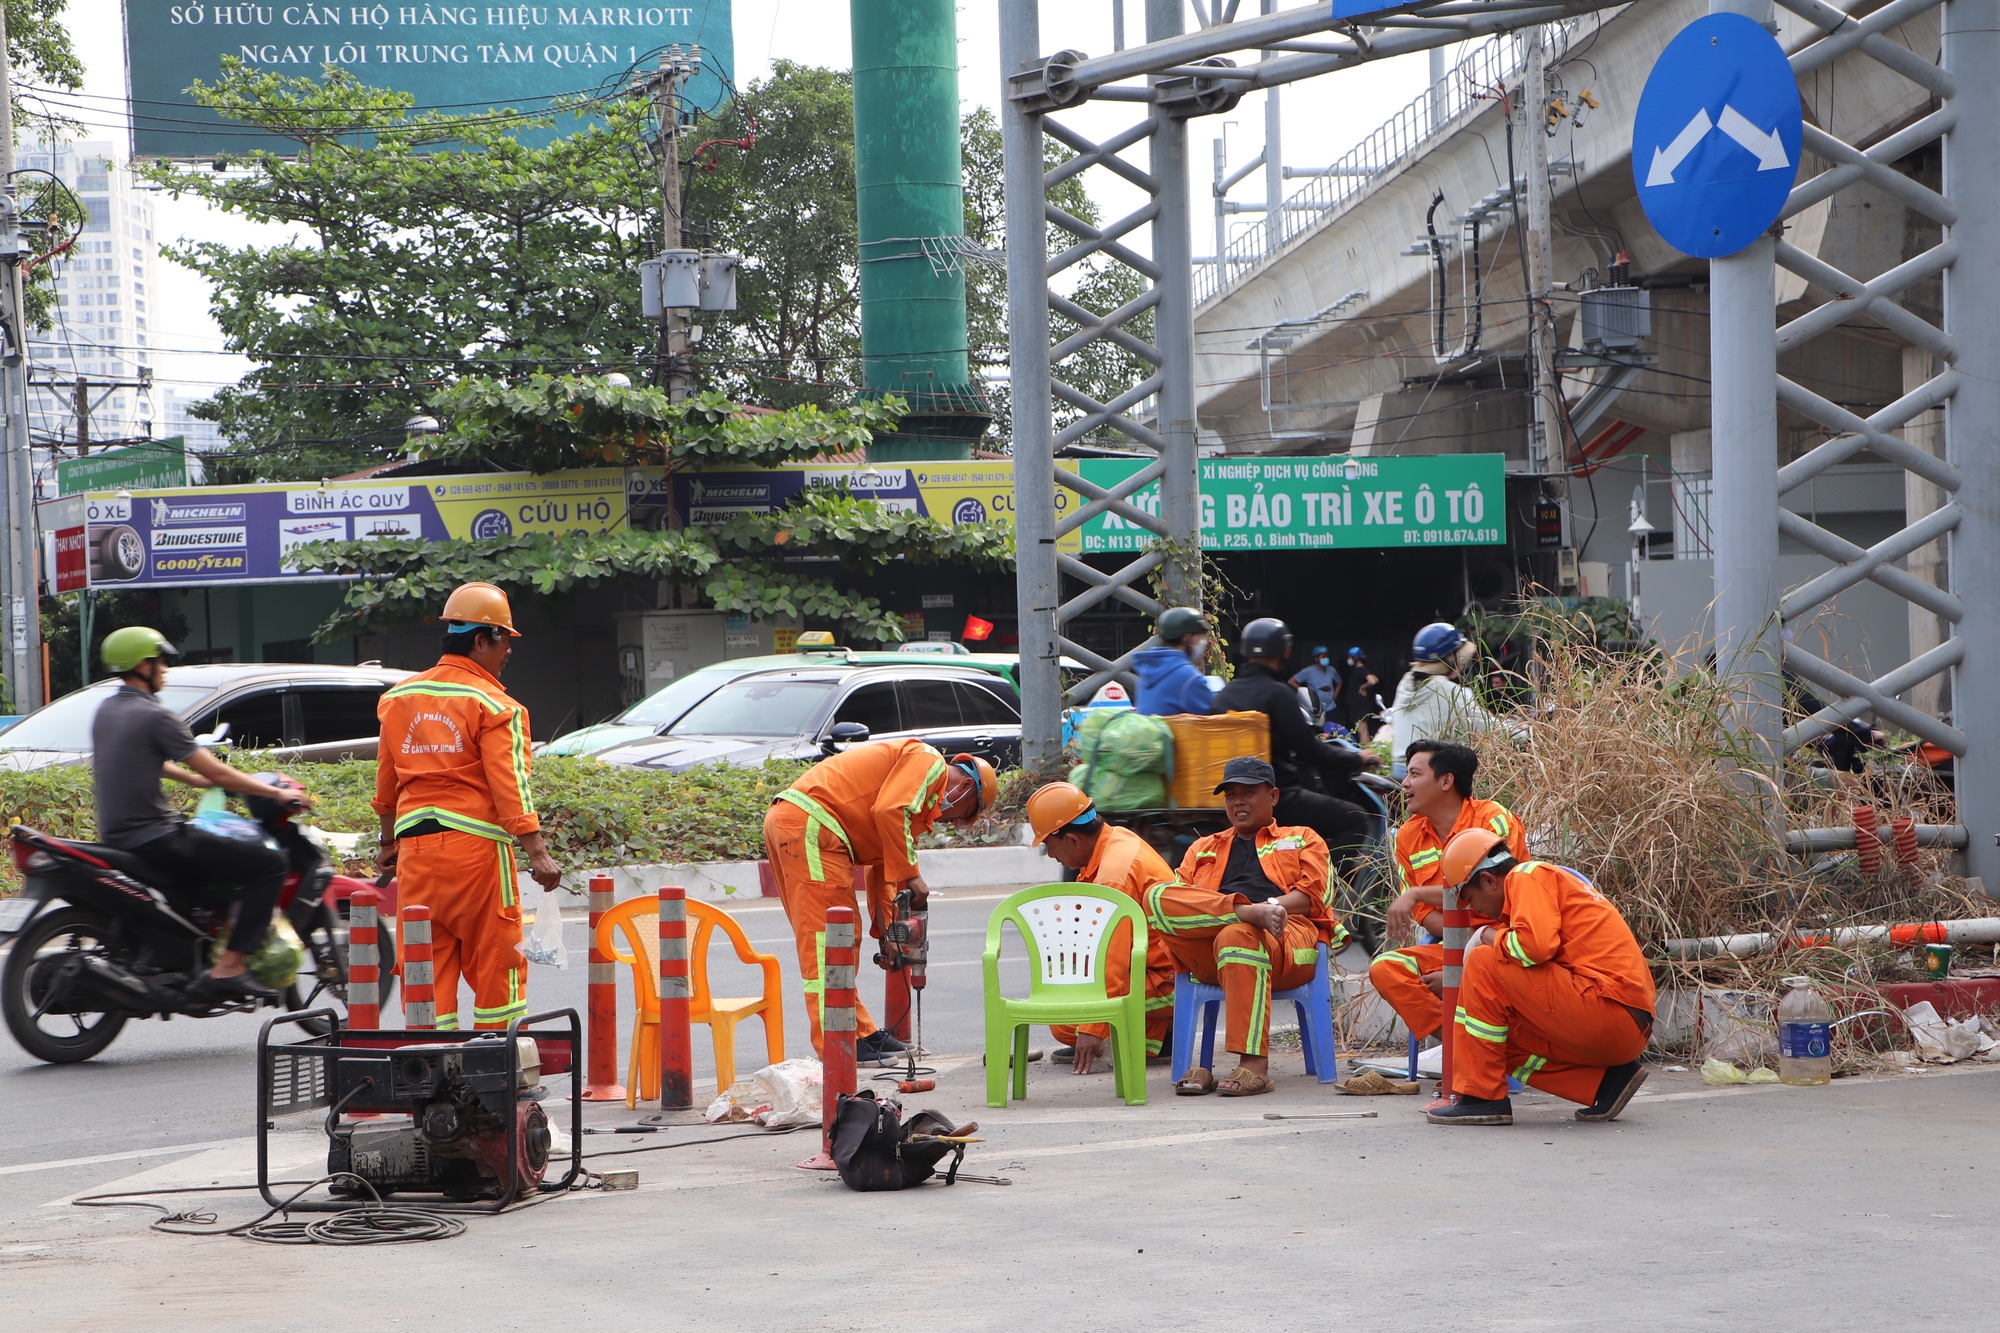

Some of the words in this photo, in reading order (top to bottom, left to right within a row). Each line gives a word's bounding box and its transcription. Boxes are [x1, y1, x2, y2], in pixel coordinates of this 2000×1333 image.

[170, 0, 205, 25] SỞ
[213, 2, 273, 25] HỮU
[282, 2, 341, 25] CĂN
[350, 3, 390, 30] HỘ
[399, 2, 478, 26] HÀNG
[487, 4, 548, 30] HIỆU
[557, 7, 693, 26] MARRIOTT
[239, 45, 315, 64] NGAY
[323, 41, 368, 64] LÕI
[376, 45, 469, 64] TRUNG
[477, 42, 535, 64] TÂM
[543, 42, 618, 68] QUẬN
[627, 45, 637, 63] 1
[874, 475, 902, 487] QUY
[931, 474, 941, 483] 028
[971, 473, 984, 482] 0948
[985, 473, 994, 482] 141
[1203, 463, 1215, 479] XÍ
[1218, 463, 1261, 482] NGHIỆP
[1264, 465, 1291, 482] DỊCH
[1294, 464, 1309, 481] VỤ
[1312, 461, 1344, 478] CÔNG
[450, 486, 461, 495] 028
[462, 485, 473, 494] 668
[474, 483, 492, 493] 46147
[497, 483, 511, 492] 0948
[513, 482, 524, 491] 141
[525, 481, 536, 491] 679
[561, 479, 578, 489] 56776
[583, 478, 598, 488] 0918
[600, 478, 611, 487] 674
[612, 477, 623, 487] 619
[706, 488, 767, 497] MICHELIN
[295, 494, 334, 511] BÌNH
[340, 490, 363, 509] ẮC
[369, 494, 404, 508] QUY
[518, 499, 568, 524] CỨU
[577, 497, 611, 525] HỘ
[1054, 489, 1068, 513] Ộ
[1226, 482, 1292, 528] BẢO
[1302, 485, 1352, 526] TRÌ
[1363, 490, 1404, 525] XE
[1414, 483, 1436, 525] Ô
[1445, 482, 1485, 524] TÔ
[170, 506, 242, 518] MICHELIN
[154, 532, 244, 546] BRIDGESTONE
[1085, 535, 1105, 549] ĐC:
[1108, 535, 1132, 549] N13
[1224, 534, 1252, 548] P.25,
[1254, 533, 1266, 547] Q.
[1269, 532, 1296, 546] Bình
[1298, 532, 1334, 549] Thạnh
[1404, 530, 1421, 543] ĐT:
[1423, 528, 1498, 543] 0918.674.619
